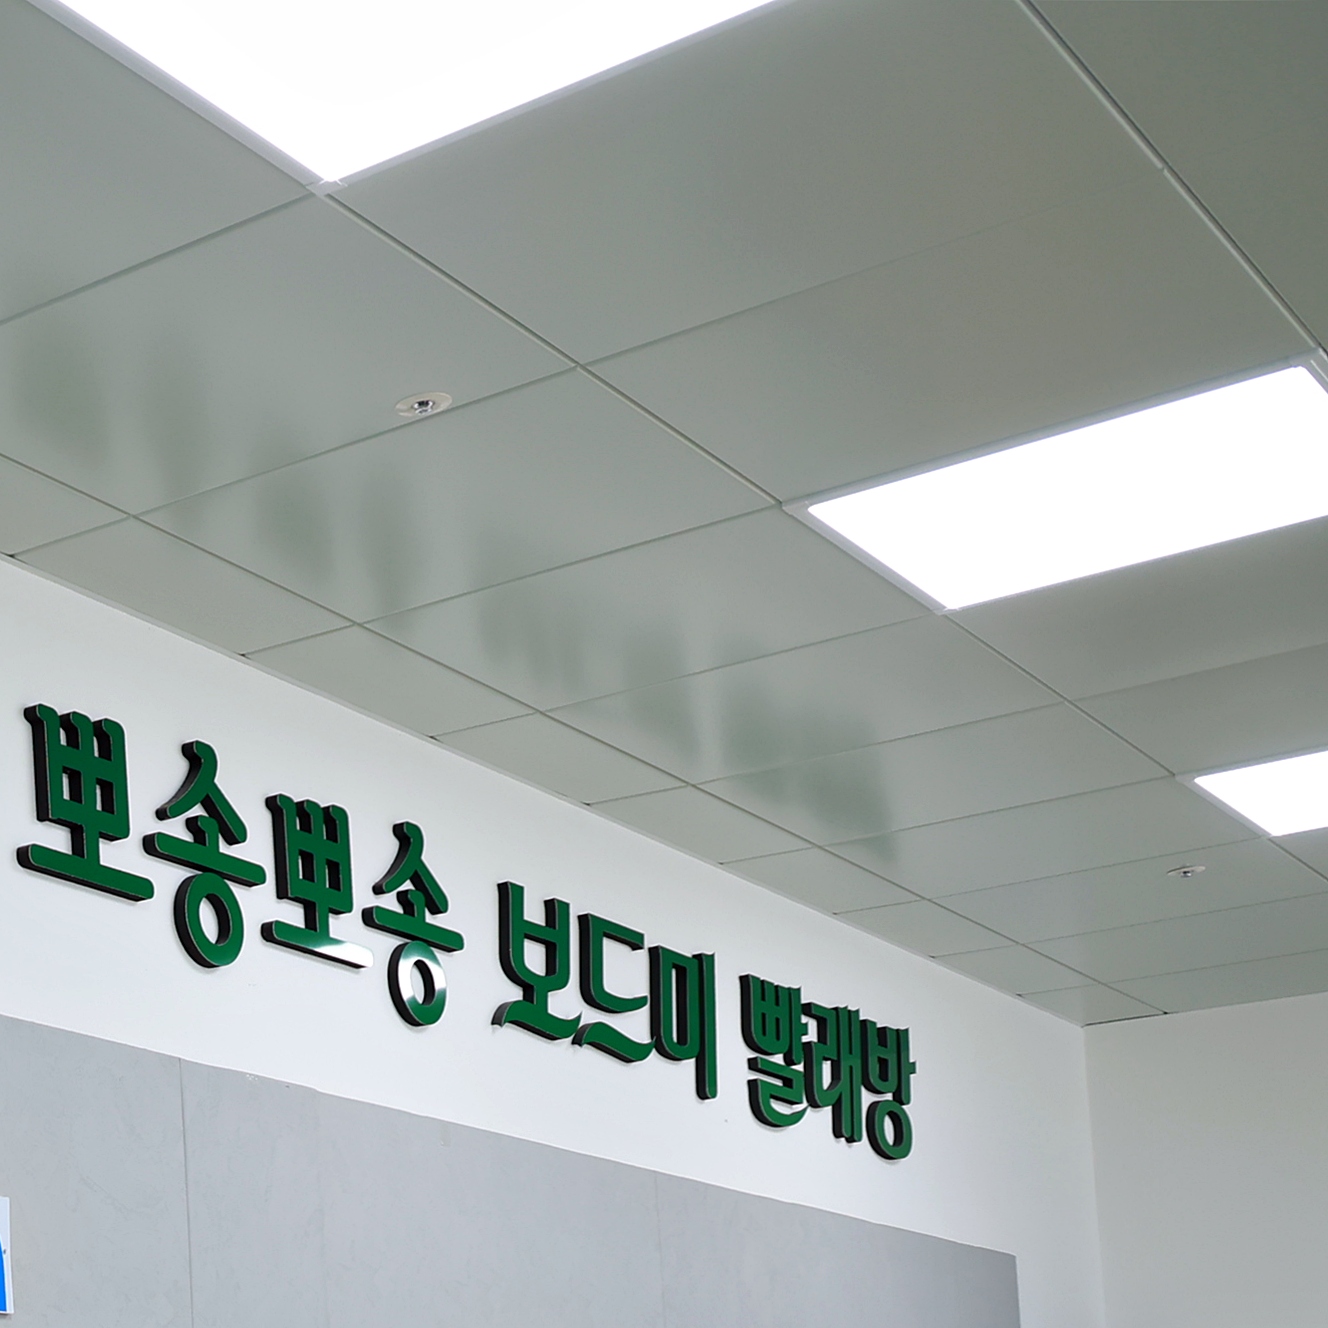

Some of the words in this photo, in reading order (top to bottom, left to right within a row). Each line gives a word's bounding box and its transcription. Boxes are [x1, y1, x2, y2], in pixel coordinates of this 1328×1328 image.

[17, 704, 464, 1026] 뽀송뽀송
[492, 880, 718, 1099] 보드미
[740, 974, 916, 1160] 빨래방
